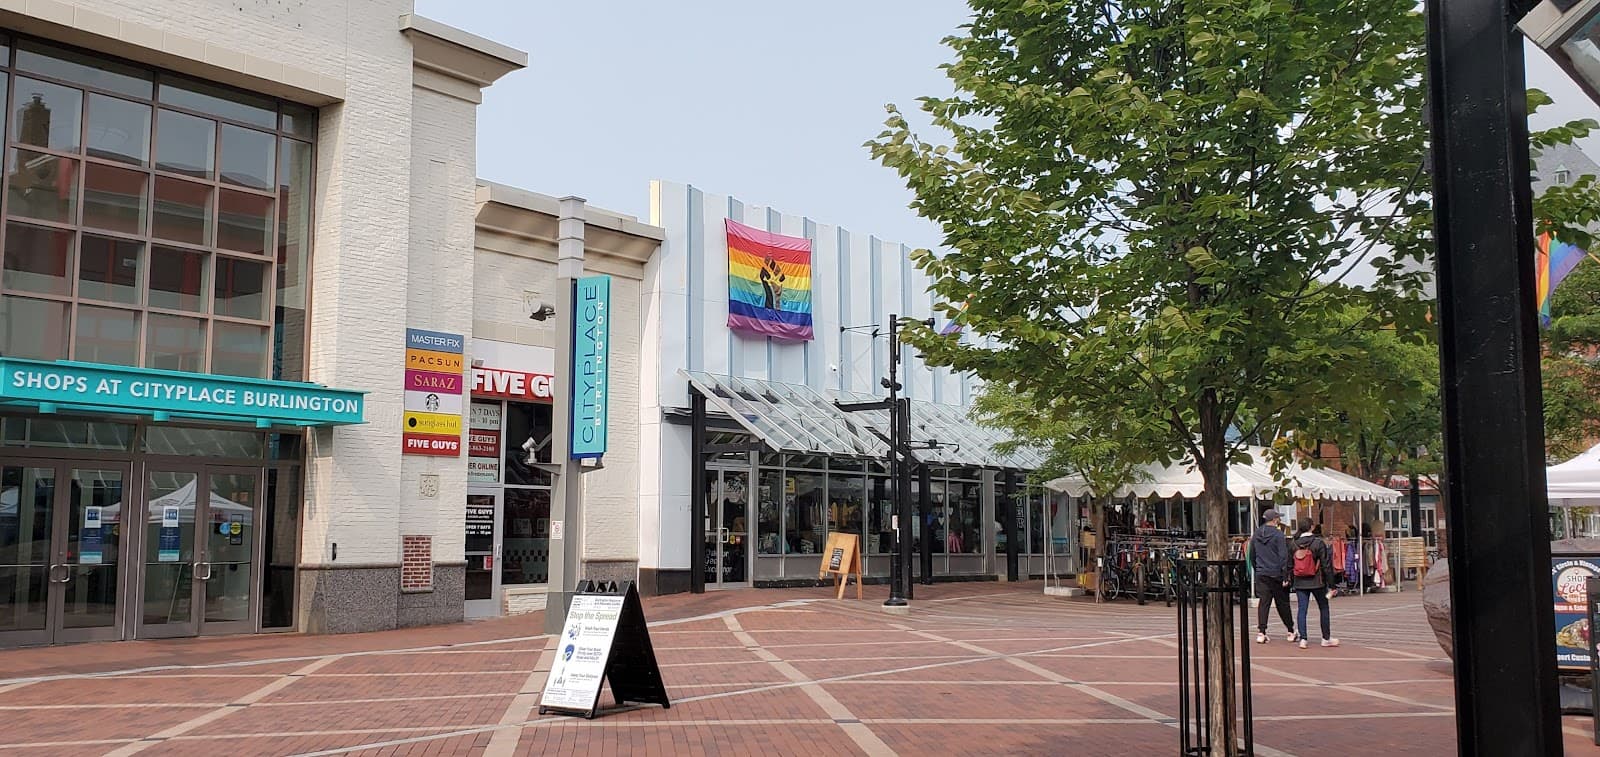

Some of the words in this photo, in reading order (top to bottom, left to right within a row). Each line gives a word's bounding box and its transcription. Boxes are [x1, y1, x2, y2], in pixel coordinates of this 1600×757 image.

[411, 334, 446, 346] MASTER
[446, 338, 460, 348] FIX
[410, 355, 460, 367] PACSUN
[582, 284, 597, 443] CITYPLACE
[594, 301, 605, 426] BURLINGTON
[471, 368, 525, 395] FIVE
[13, 370, 88, 393] SHOPS
[96, 379, 122, 395] AT
[129, 381, 236, 405] CITYPLACE
[243, 390, 359, 414] BURLINGTON
[407, 438, 430, 448] FIVE
[431, 439, 458, 450] GUYS
[570, 610, 584, 621] Stop
[584, 610, 594, 620] the
[595, 611, 618, 622] Spread
